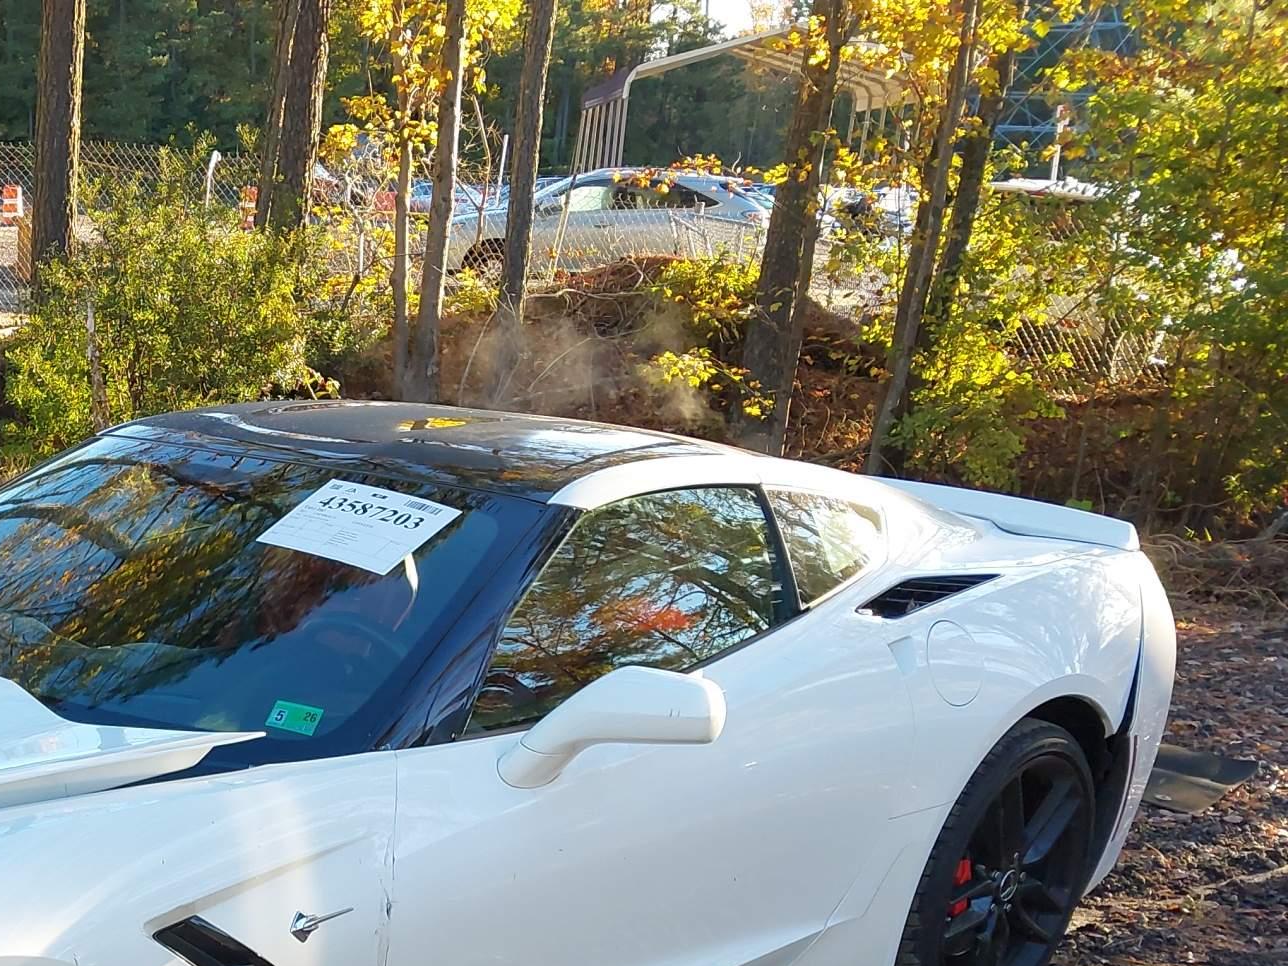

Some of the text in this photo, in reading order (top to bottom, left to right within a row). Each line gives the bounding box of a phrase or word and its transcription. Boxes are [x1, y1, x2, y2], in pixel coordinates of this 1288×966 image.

[319, 496, 425, 530] 43587203
[275, 710, 317, 722] 5 26
